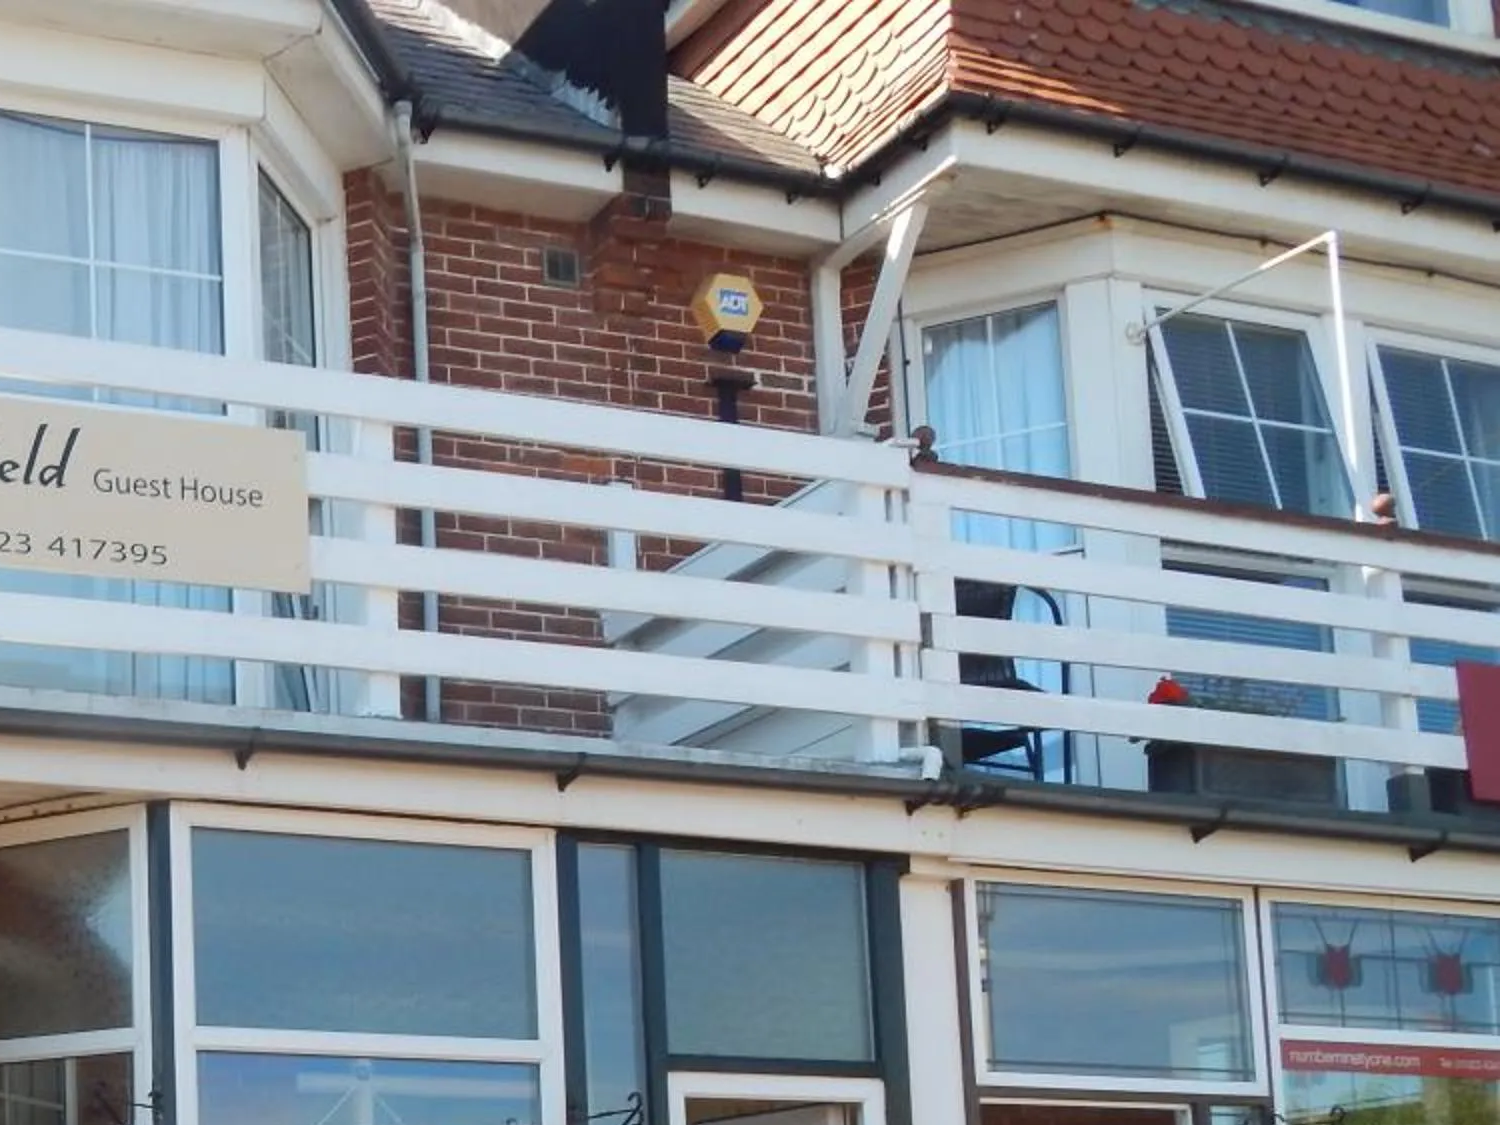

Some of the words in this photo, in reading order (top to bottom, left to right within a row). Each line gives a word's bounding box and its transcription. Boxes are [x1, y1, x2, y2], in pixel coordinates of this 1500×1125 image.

[92, 468, 172, 500] Guest
[179, 477, 263, 508] House
[47, 534, 169, 566] 417395
